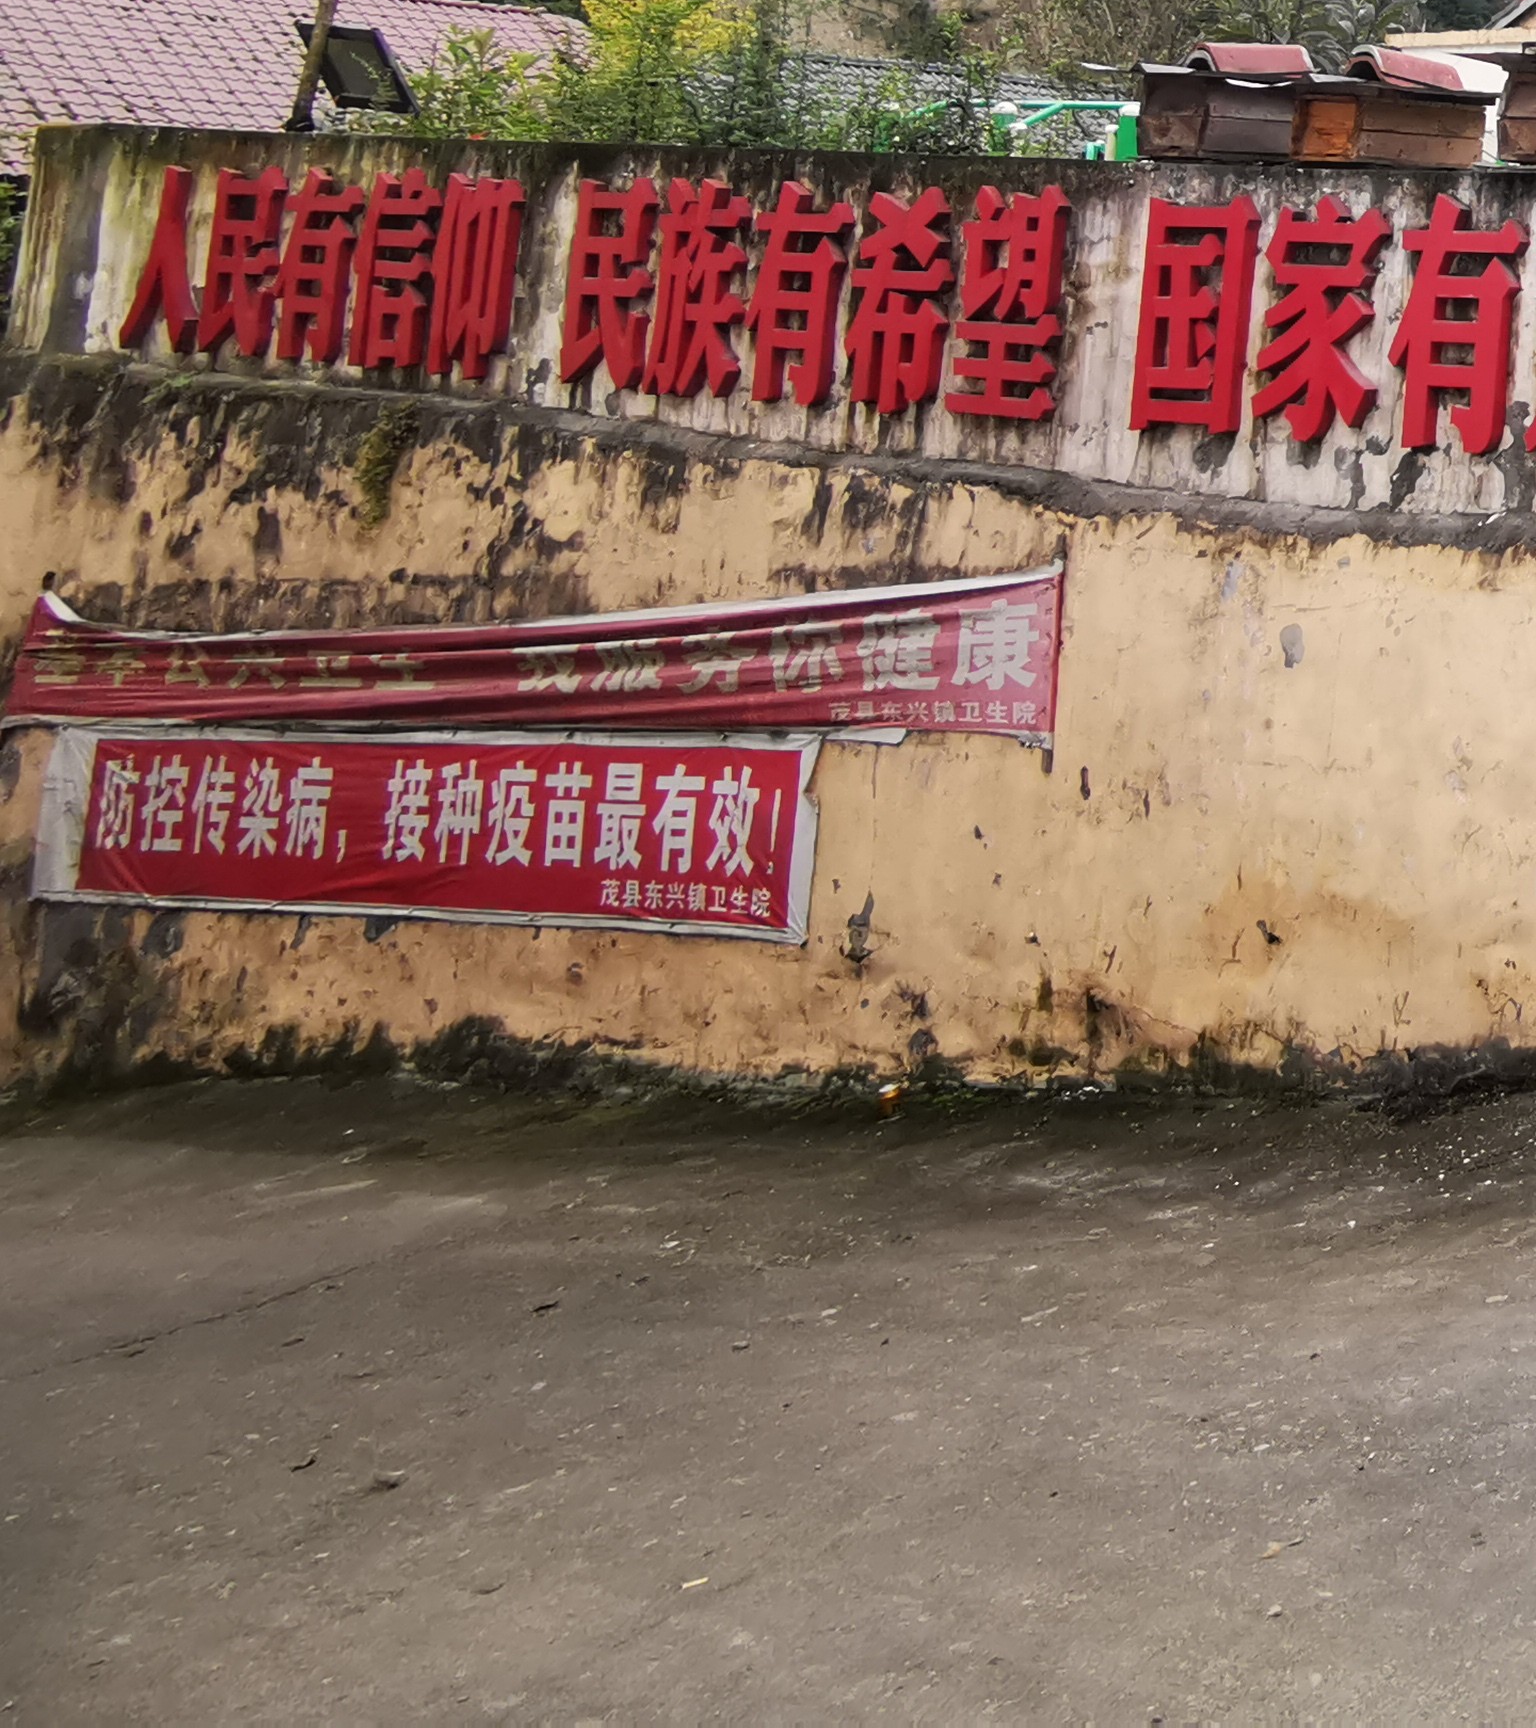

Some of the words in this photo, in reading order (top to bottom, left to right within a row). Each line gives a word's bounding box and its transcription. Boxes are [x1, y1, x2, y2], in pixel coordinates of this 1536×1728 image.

[120, 165, 524, 380] 人民有信仰
[560, 176, 1069, 420] 民族有希望
[600, 878, 772, 918] 茂县东兴镇卫生院
